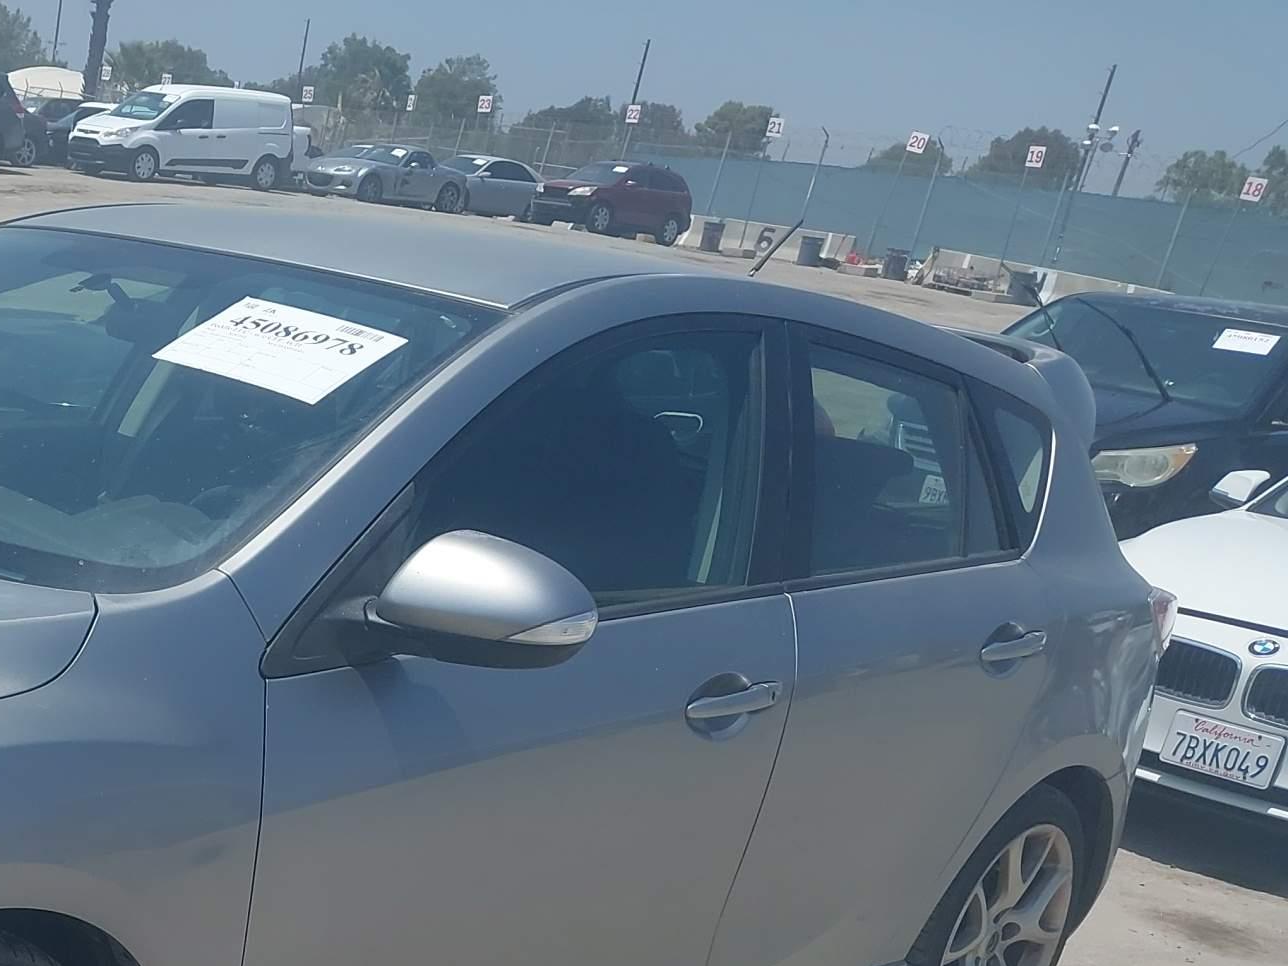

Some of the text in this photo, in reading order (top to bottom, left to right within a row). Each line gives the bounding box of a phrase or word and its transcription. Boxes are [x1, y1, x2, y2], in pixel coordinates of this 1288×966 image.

[303, 89, 313, 99] 25
[479, 98, 491, 109] 23
[628, 109, 640, 119] 22
[768, 121, 782, 134] 21
[909, 135, 926, 150] 20
[1027, 150, 1043, 163] 19
[1243, 181, 1263, 197] 18
[756, 227, 776, 253] 6
[229, 315, 364, 356] 45086978
[1193, 719, 1260, 748] California
[1171, 731, 1269, 780] 7BXK049
